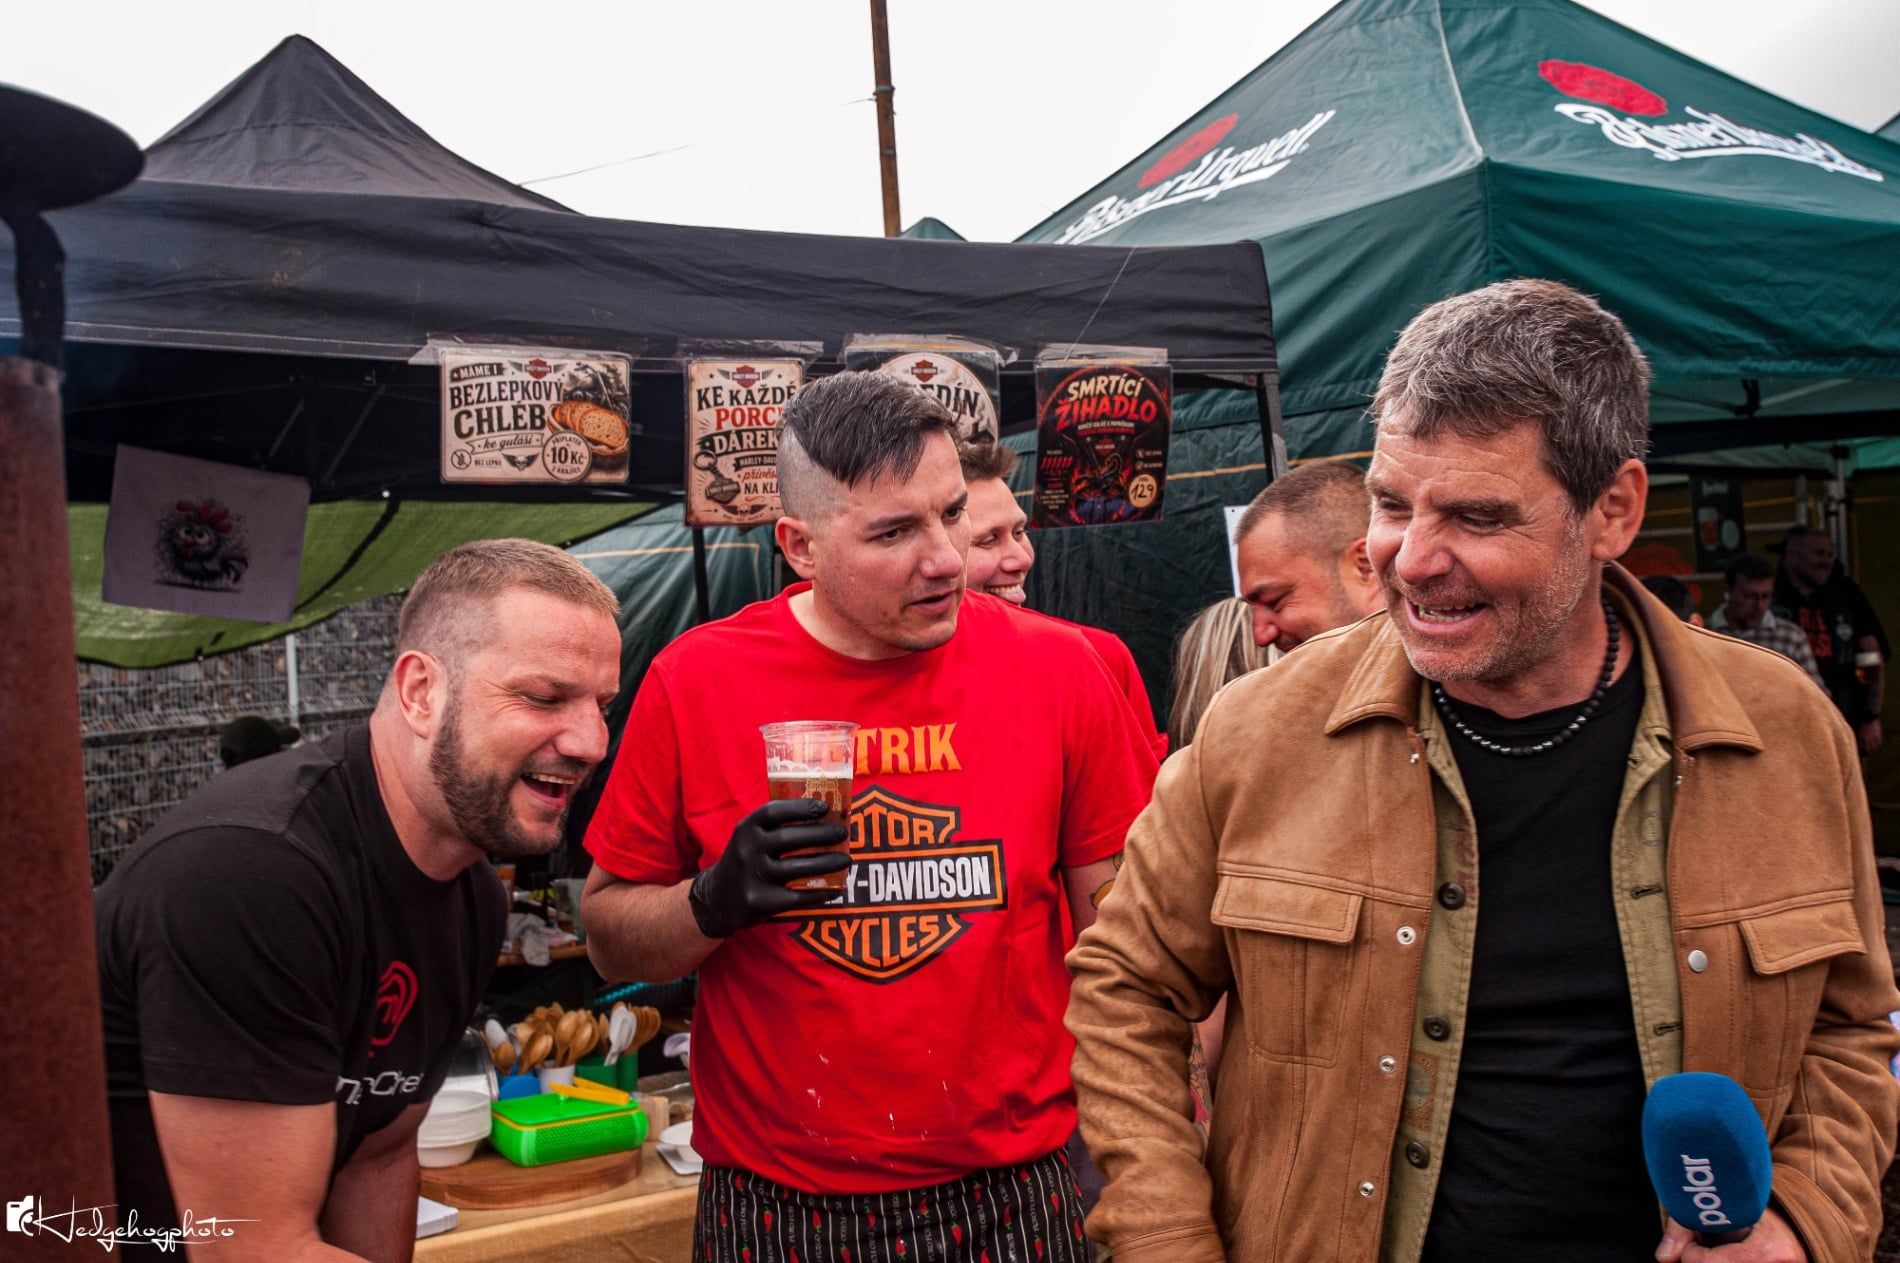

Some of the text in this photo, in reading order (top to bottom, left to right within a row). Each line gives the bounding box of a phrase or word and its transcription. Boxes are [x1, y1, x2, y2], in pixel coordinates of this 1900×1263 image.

[449, 378, 564, 410] BEZLEPKOVÝ
[697, 380, 797, 411] KE KAŽDÉ
[1067, 373, 1145, 402] SMRTÍCÍ
[454, 400, 547, 440] CHLÉB
[1055, 394, 1157, 433] ŽIHADLO
[483, 437, 497, 450] ke
[551, 446, 585, 465] 10 Kč
[712, 429, 779, 454] DÁREK
[744, 482, 758, 494] NA
[853, 722, 962, 775] TRIK
[850, 803, 935, 848] OTOR
[820, 914, 940, 968] CYCLES
[1680, 1154, 1732, 1226] polar
